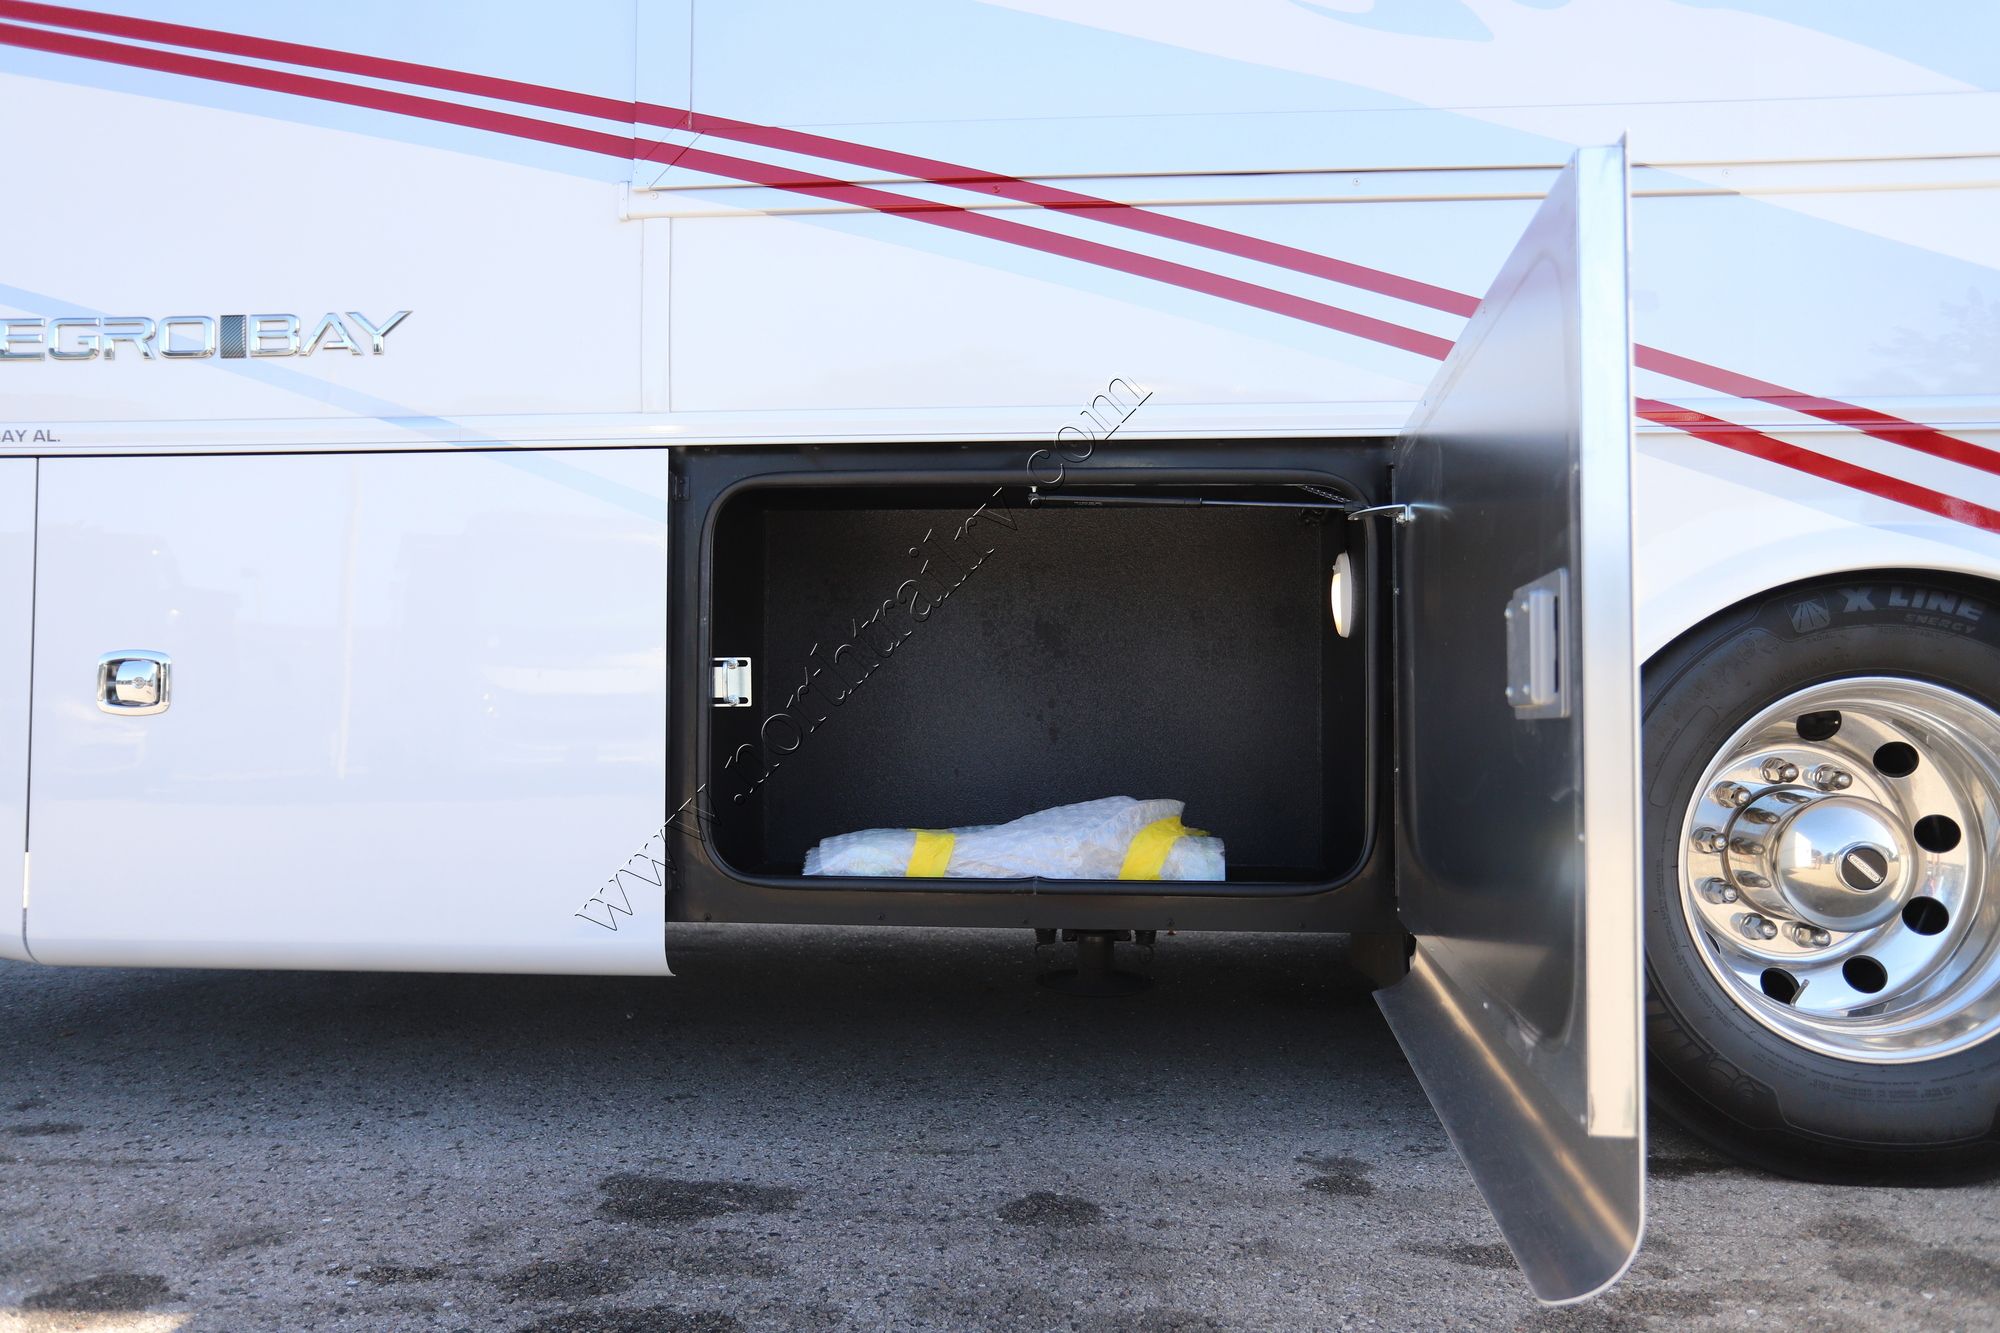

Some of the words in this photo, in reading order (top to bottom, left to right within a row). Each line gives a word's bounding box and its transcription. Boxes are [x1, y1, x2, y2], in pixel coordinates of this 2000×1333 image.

[0, 315, 216, 361] EGRO
[250, 310, 413, 358] BAY
[0, 429, 28, 443] AY
[33, 429, 61, 443] AL.
[1838, 587, 1876, 613] X
[1888, 586, 1985, 621] LINE
[1904, 613, 1976, 633] ENERGY
